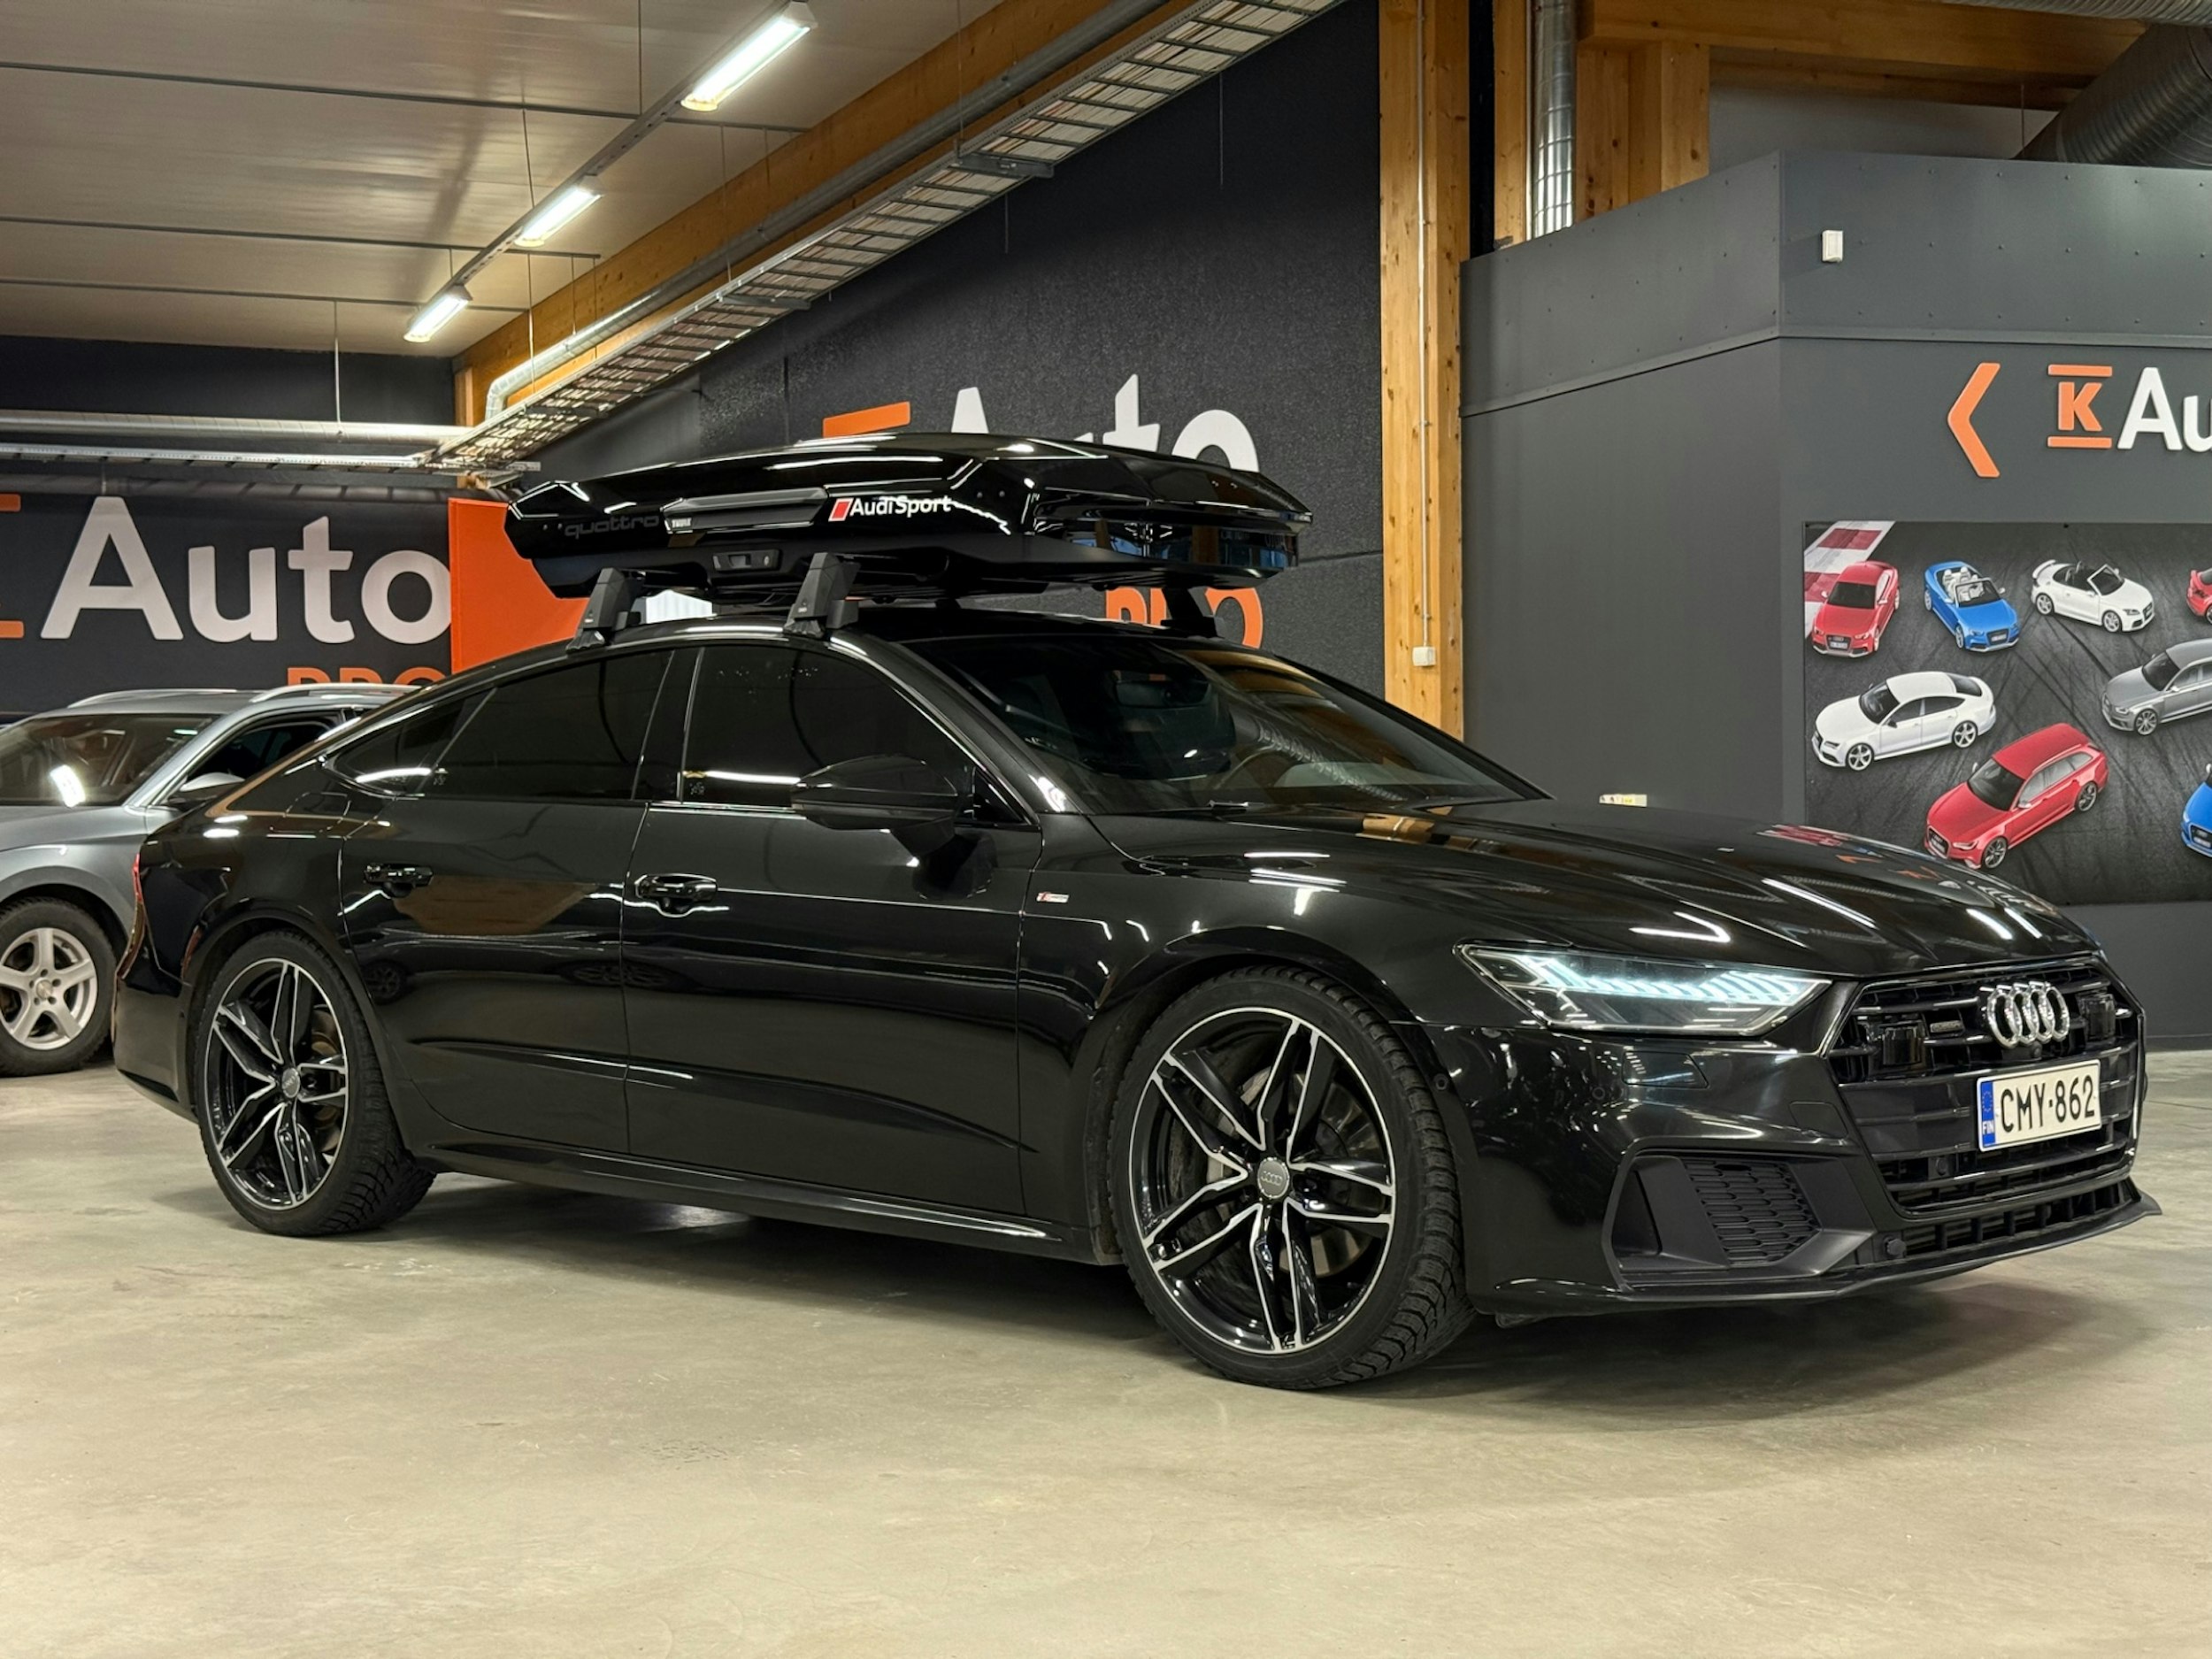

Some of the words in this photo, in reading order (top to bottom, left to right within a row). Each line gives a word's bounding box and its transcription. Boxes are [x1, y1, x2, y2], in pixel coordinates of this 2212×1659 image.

[565, 516, 659, 539] quattro
[41, 496, 451, 643] Auto
[2001, 1074, 2095, 1133] CMY-862
